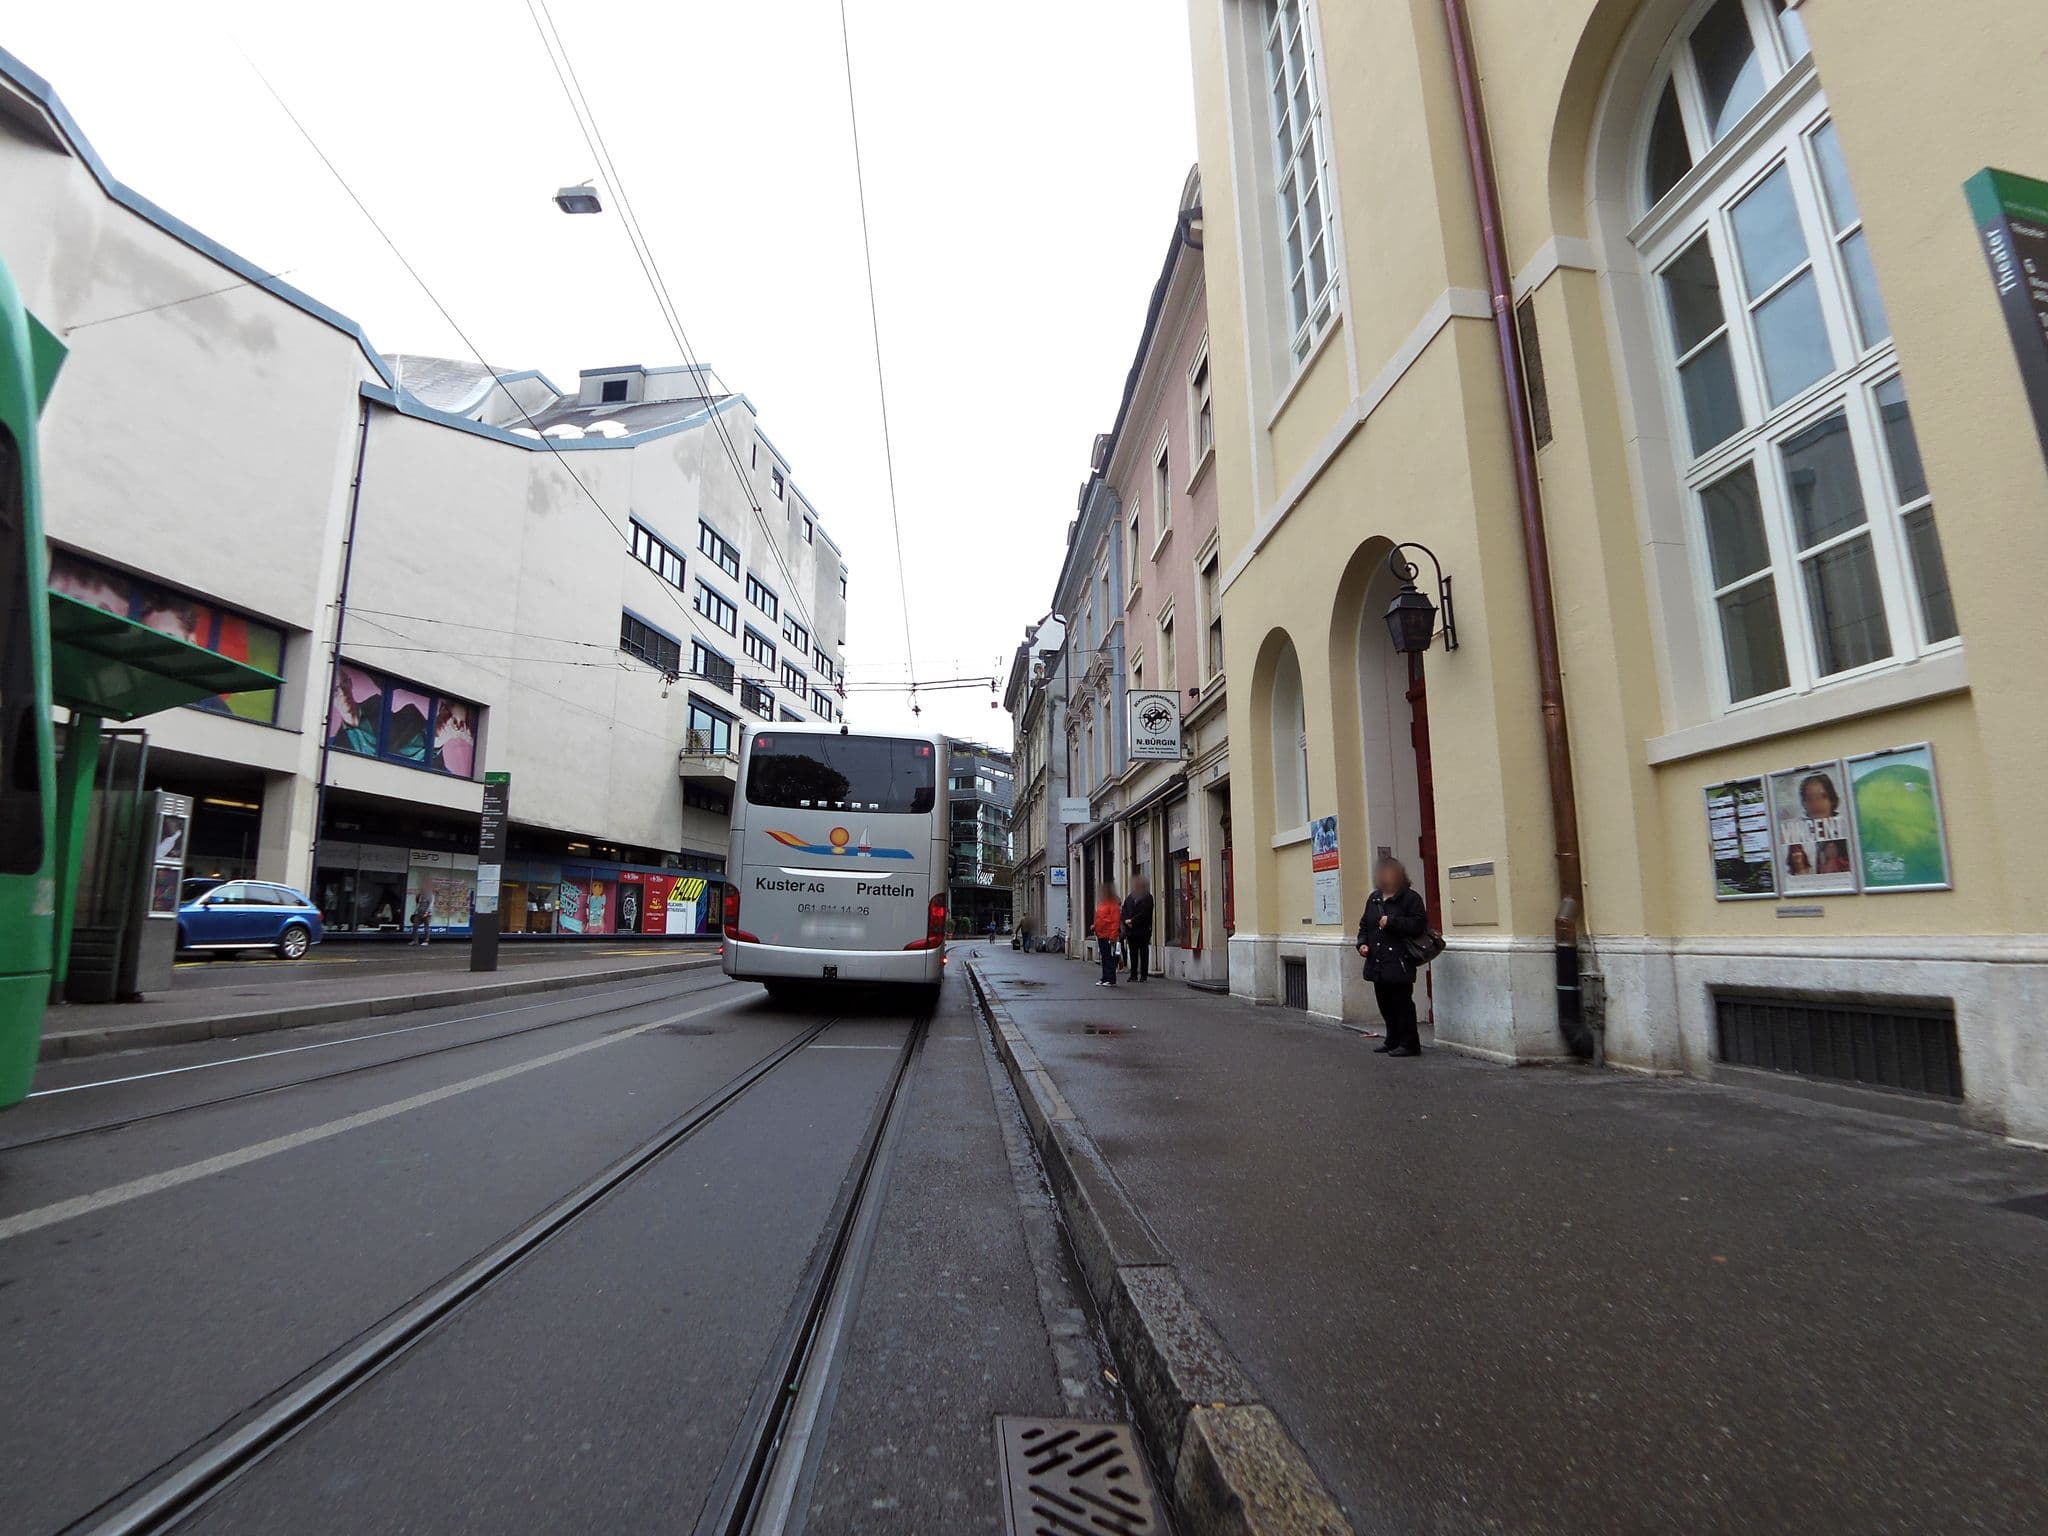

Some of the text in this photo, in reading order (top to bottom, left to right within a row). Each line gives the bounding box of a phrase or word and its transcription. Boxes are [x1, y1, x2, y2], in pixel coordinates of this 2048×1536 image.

[1985, 229, 2017, 296] Theater
[1136, 737, 1176, 746] N.BÜRGIN
[800, 799, 879, 810] SETRA
[667, 876, 707, 902] HALLO
[755, 877, 914, 898] Kuster AG Pratteln
